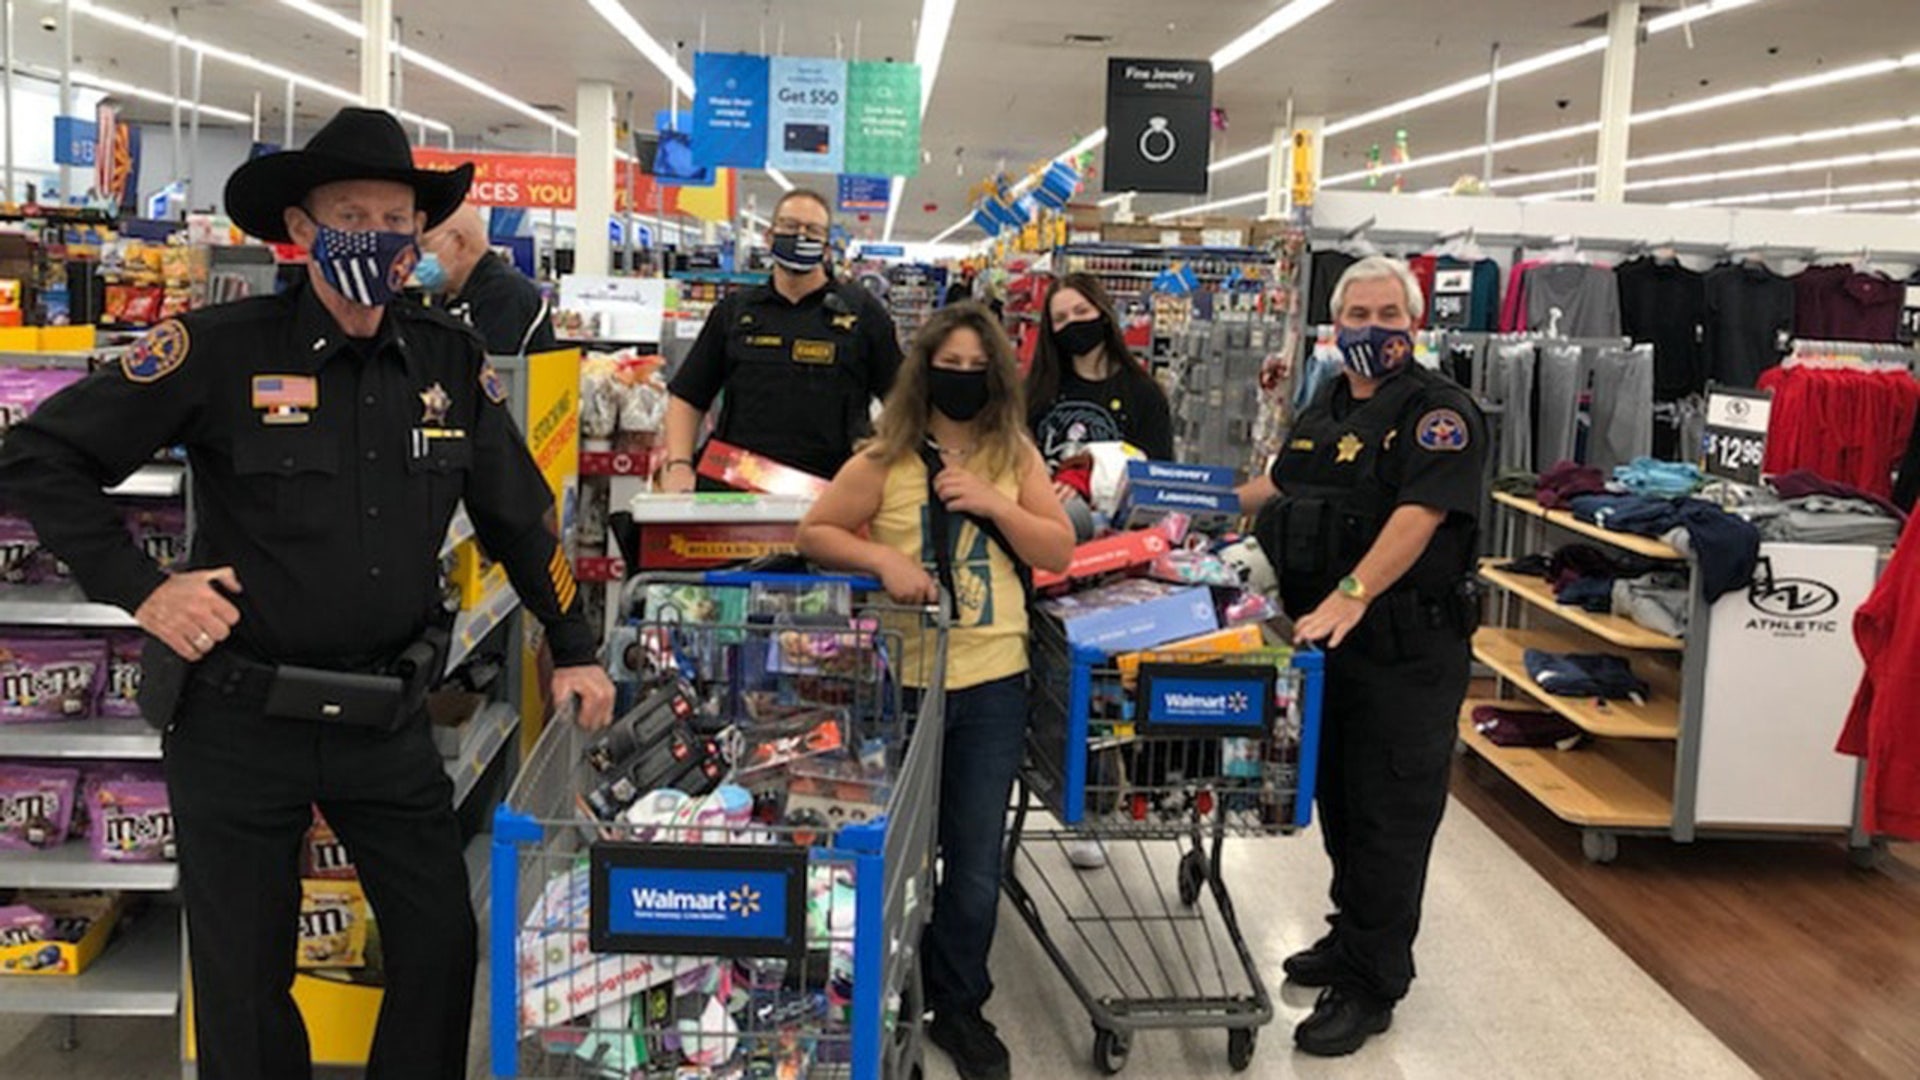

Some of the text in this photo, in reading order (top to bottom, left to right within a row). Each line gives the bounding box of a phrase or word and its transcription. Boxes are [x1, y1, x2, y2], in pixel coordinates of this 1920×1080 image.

[1152, 67, 1195, 84] Jewelry
[778, 87, 839, 105] Get $50
[527, 184, 572, 202] YOU
[1149, 464, 1211, 482] Discovery
[1745, 618, 1838, 633] ATHLETIC
[1164, 693, 1226, 709] Walmart
[632, 887, 727, 911] Walmart
